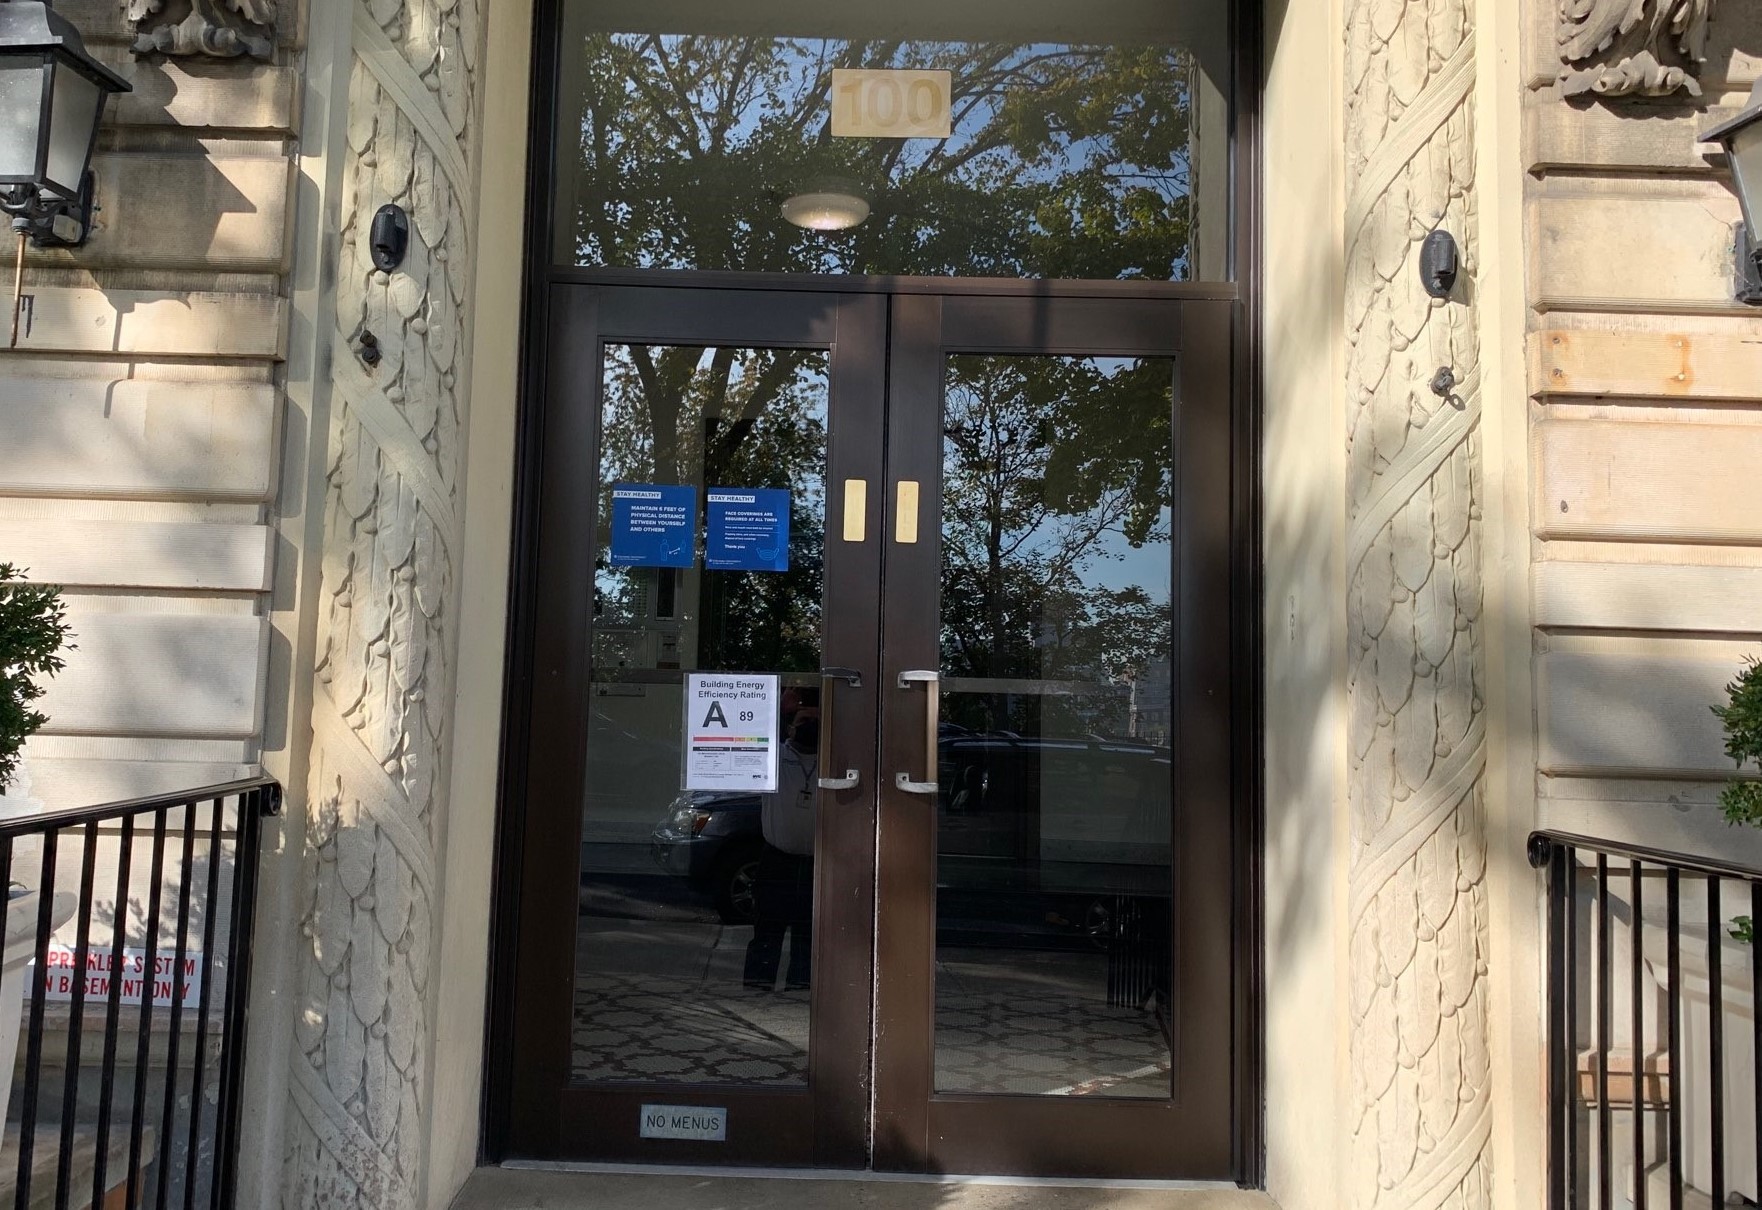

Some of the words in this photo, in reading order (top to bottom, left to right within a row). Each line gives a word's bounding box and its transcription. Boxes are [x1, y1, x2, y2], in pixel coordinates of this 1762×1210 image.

[840, 77, 943, 127] 100
[700, 680, 734, 689] Building
[736, 681, 765, 690] Energy
[698, 691, 738, 700] Efficiency
[740, 691, 767, 700] Rating
[702, 701, 729, 728] A
[739, 711, 754, 722] 89
[133, 956, 195, 976] SSTM
[152, 981, 190, 999] ONY
[646, 1115, 666, 1128] NO
[671, 1116, 720, 1130] MENUS
